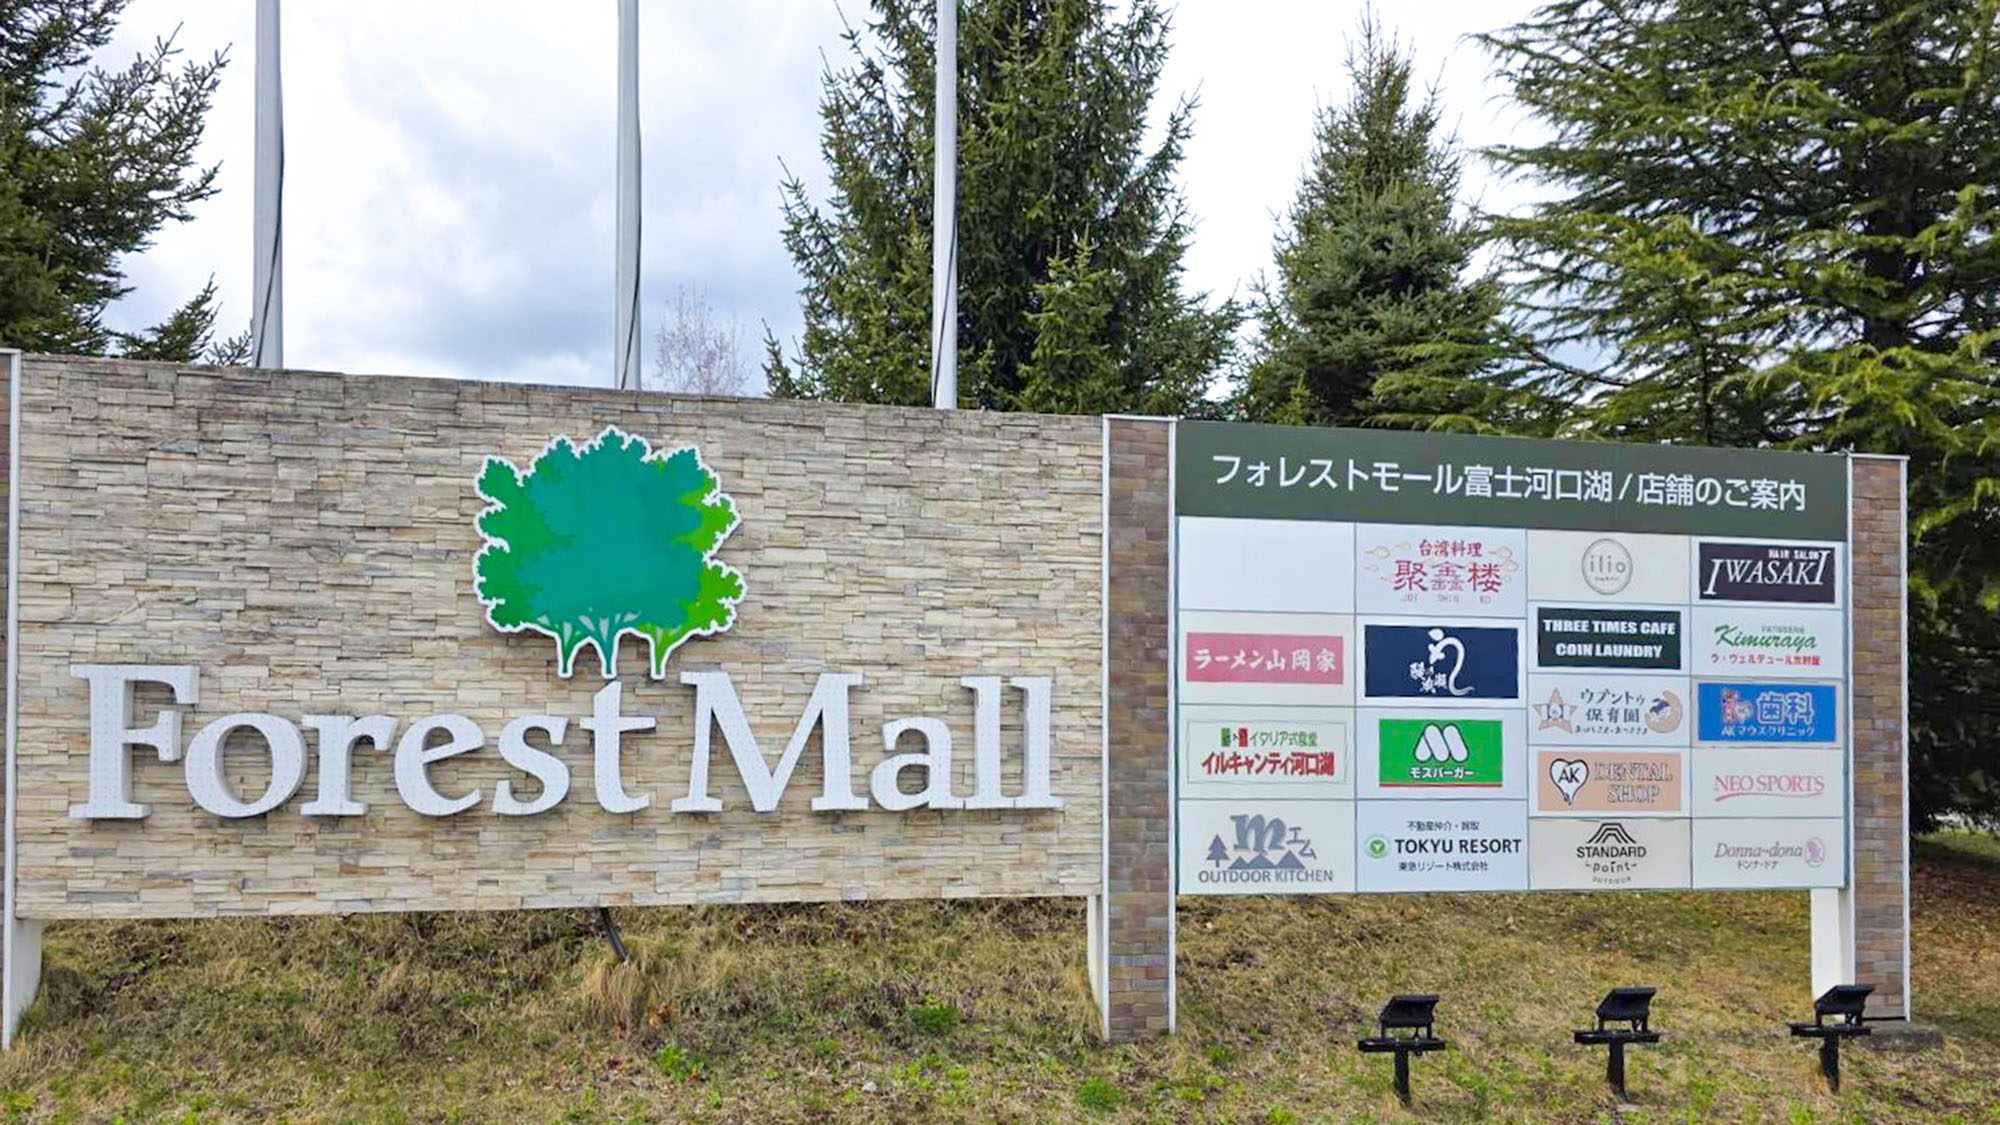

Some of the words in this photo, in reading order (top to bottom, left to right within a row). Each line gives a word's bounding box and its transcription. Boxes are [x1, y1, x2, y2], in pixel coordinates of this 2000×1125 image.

[1420, 539, 1482, 557] 台湾料理
[1768, 549, 1790, 559] HAIR
[1793, 550, 1819, 560] SALON
[1590, 555, 1626, 573] ilio
[1703, 550, 1831, 595] IWASAKI
[1393, 560, 1502, 593] 聚鑫楼
[1543, 619, 1589, 632] THREE
[1592, 621, 1637, 633] TIMES
[1640, 622, 1676, 635] CAFE
[1714, 624, 1818, 653] Kimuraya
[1556, 643, 1593, 656] COIN
[1595, 644, 1663, 658] LAUNDRY
[1193, 648, 1336, 672] ラーメン山岡家
[1586, 708, 1640, 723] 保育園
[1757, 691, 1814, 725] 歯科
[69, 664, 655, 819] Forest
[671, 671, 1064, 812] Mall
[1201, 751, 1335, 776] イルキャンティ河口湖
[1594, 762, 1673, 781] DENTAL
[1410, 767, 1474, 779] モスバーガー
[1558, 767, 1580, 784] AK
[1714, 775, 1754, 791] NEO
[1757, 775, 1825, 792] SPORTS
[1607, 784, 1660, 803] SHOP
[1395, 839, 1453, 854] TOKYU
[1459, 839, 1522, 854] RESORT
[1577, 846, 1647, 858] STANDARD
[1398, 861, 1488, 872] 東急リゾート株式会社
[1198, 870, 1271, 883] OUTDOOR
